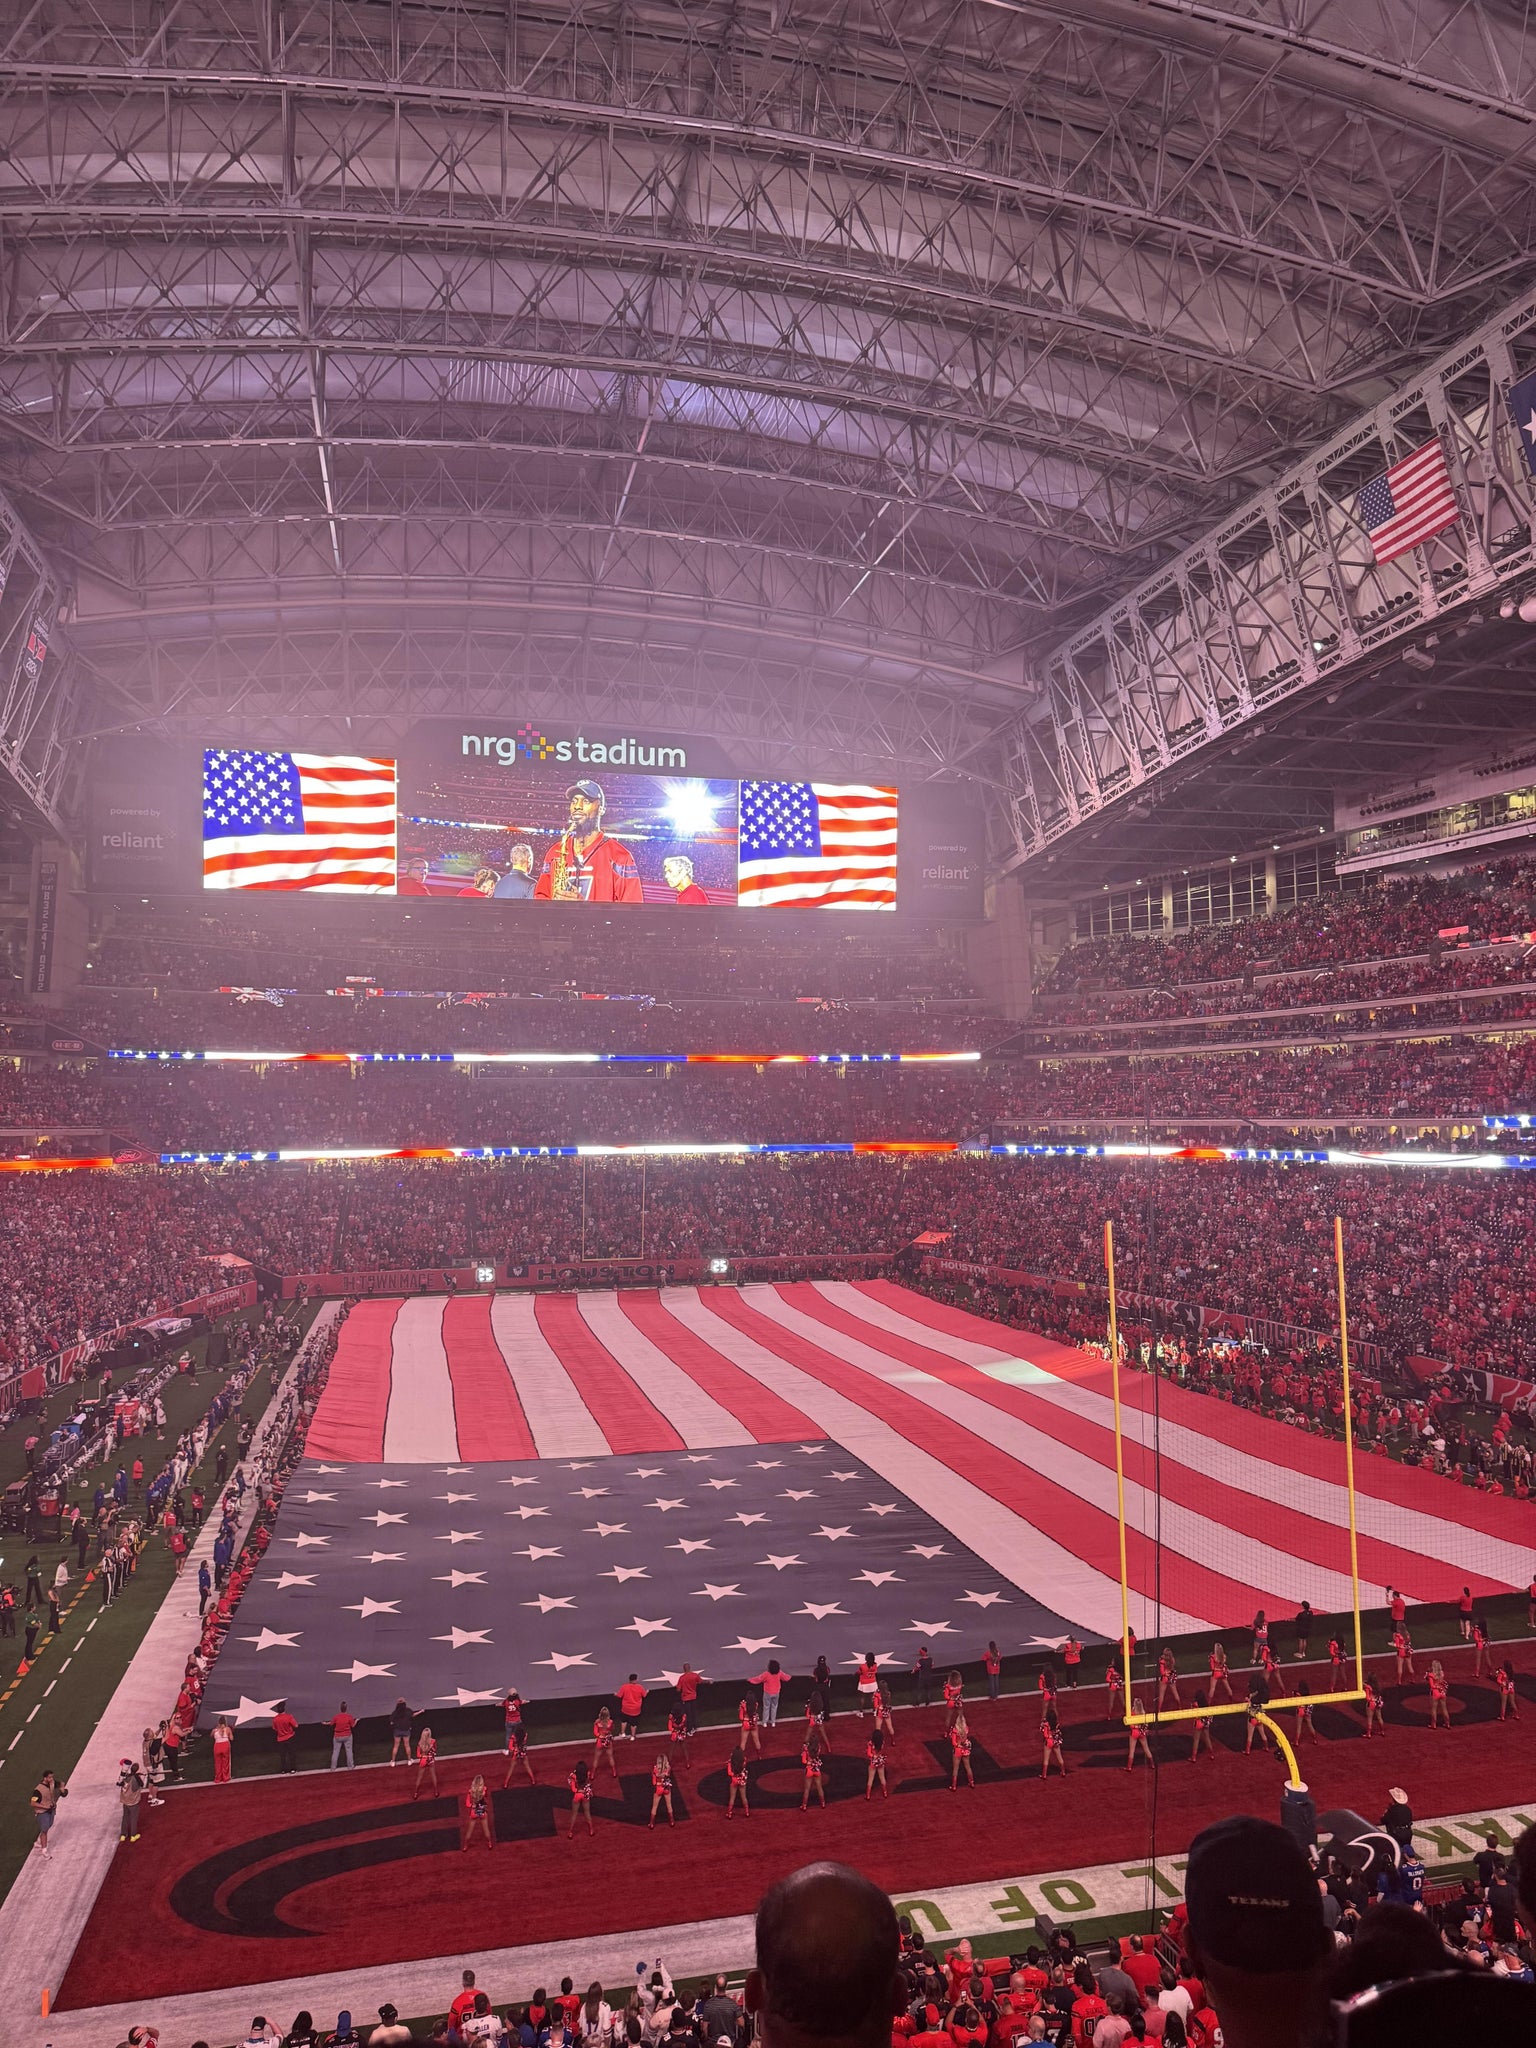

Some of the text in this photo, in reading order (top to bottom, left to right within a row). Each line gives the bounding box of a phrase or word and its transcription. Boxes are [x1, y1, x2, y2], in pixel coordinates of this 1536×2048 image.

[462, 735, 687, 768] nrg stadium
[110, 808, 161, 818] powered by
[102, 831, 165, 849] reliant
[928, 844, 968, 854] powered by
[922, 865, 970, 880] reliant
[537, 1263, 676, 1282] HOUSTON
[713, 1260, 728, 1273] 25
[940, 1260, 989, 1275] HOUSTON
[343, 1273, 398, 1291] HTOWN
[478, 1269, 494, 1281] 25
[206, 1287, 241, 1307] HOUSTON
[169, 1671, 1536, 1938] OUSTON
[989, 1879, 1097, 1923] OF
[1228, 1895, 1290, 1908] TEXANS
